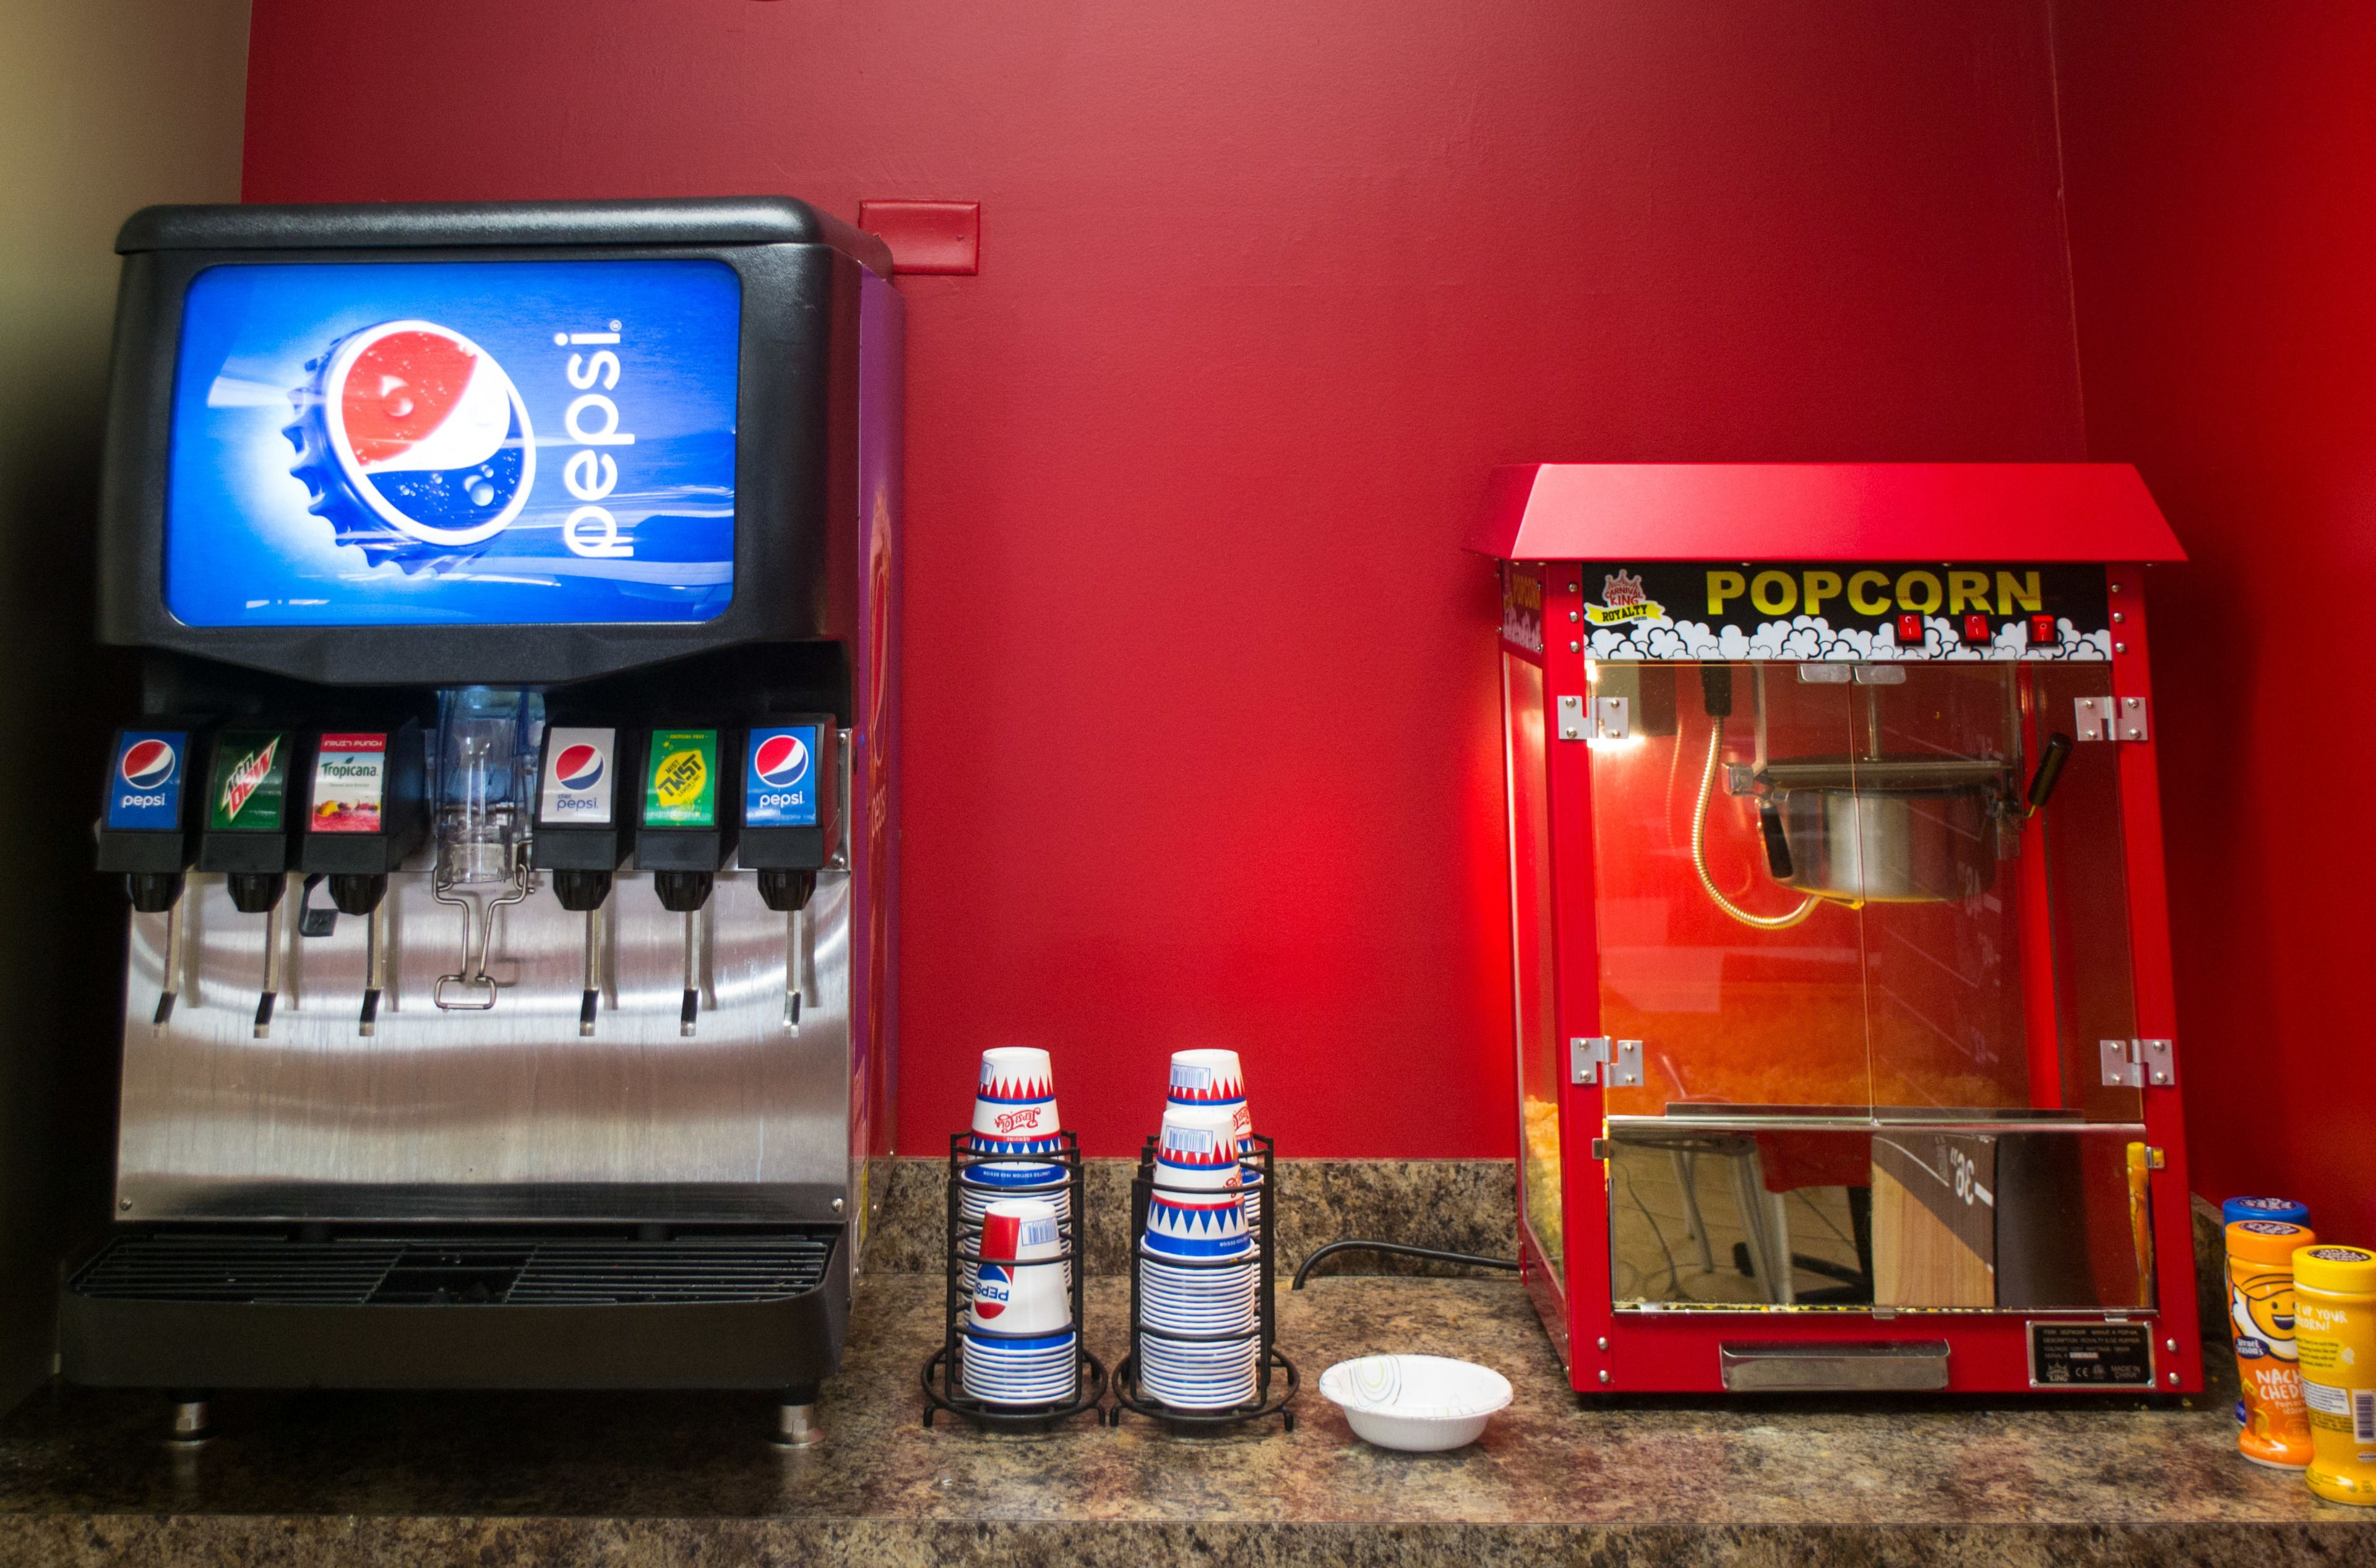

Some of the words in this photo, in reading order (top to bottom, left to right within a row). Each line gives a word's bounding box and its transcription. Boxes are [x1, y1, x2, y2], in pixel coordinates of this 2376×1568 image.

[555, 333, 635, 558] pepsi
[1605, 587, 1643, 599] CARNIVAL
[1610, 595, 1639, 606] KING
[1706, 571, 2042, 616] POPCORN
[1602, 605, 1647, 622] ROYALTY
[321, 762, 377, 779] Tropicana
[665, 759, 681, 774] MIST
[122, 793, 166, 809] pepsi
[557, 797, 598, 812] pepsi
[760, 790, 803, 809] pepsi
[2316, 1309, 2348, 1324] YOUR
